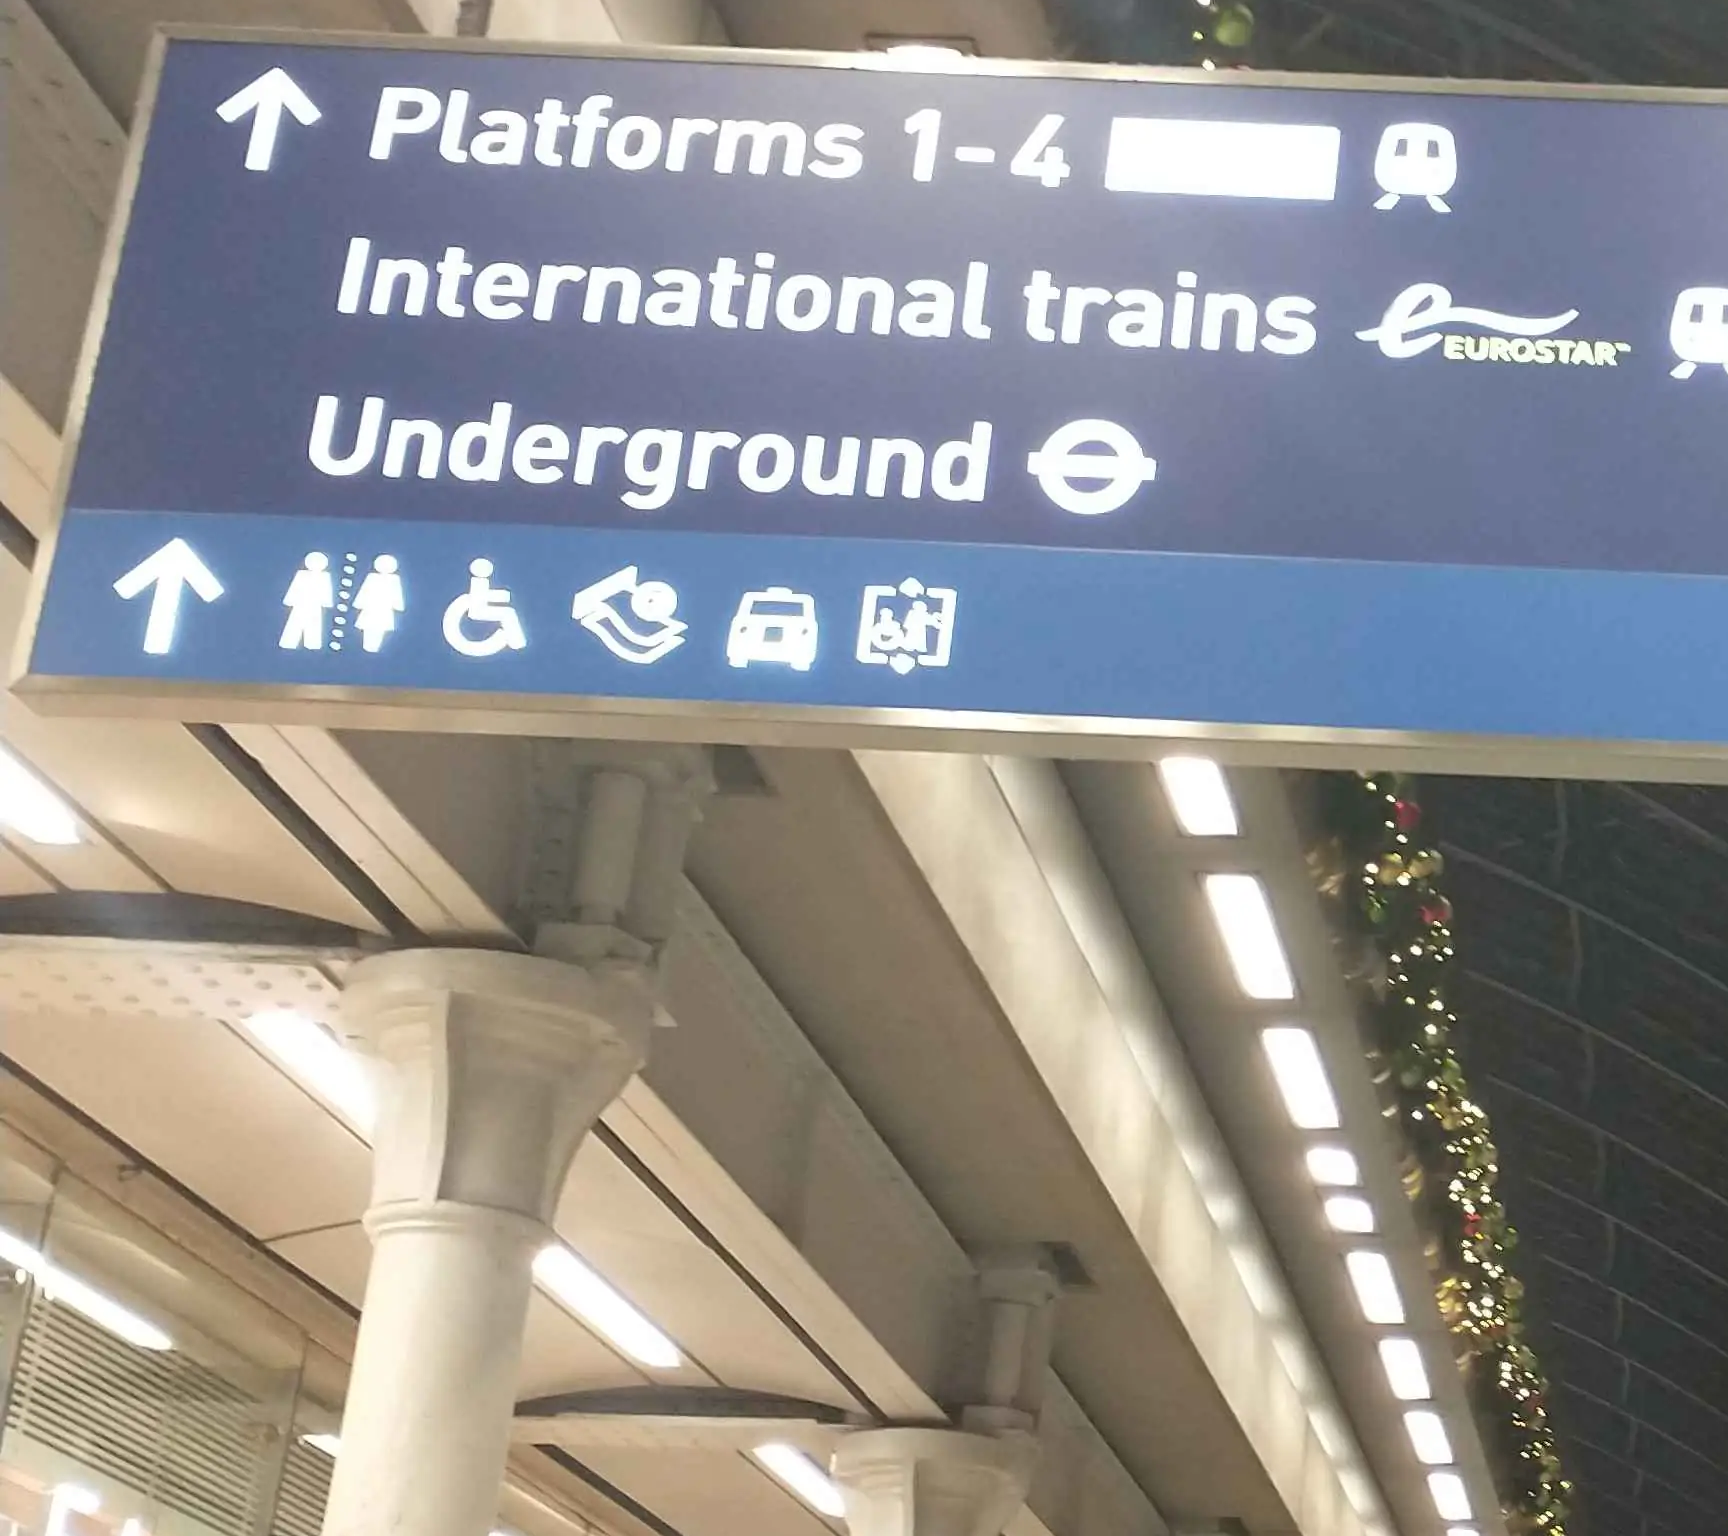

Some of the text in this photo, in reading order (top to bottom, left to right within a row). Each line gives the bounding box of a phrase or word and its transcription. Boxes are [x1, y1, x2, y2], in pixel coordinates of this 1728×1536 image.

[367, 84, 1073, 189] Platforms 1-4
[336, 236, 1318, 356] International trains
[1442, 333, 1620, 367] EUROSTAR
[306, 394, 993, 510] Underground
